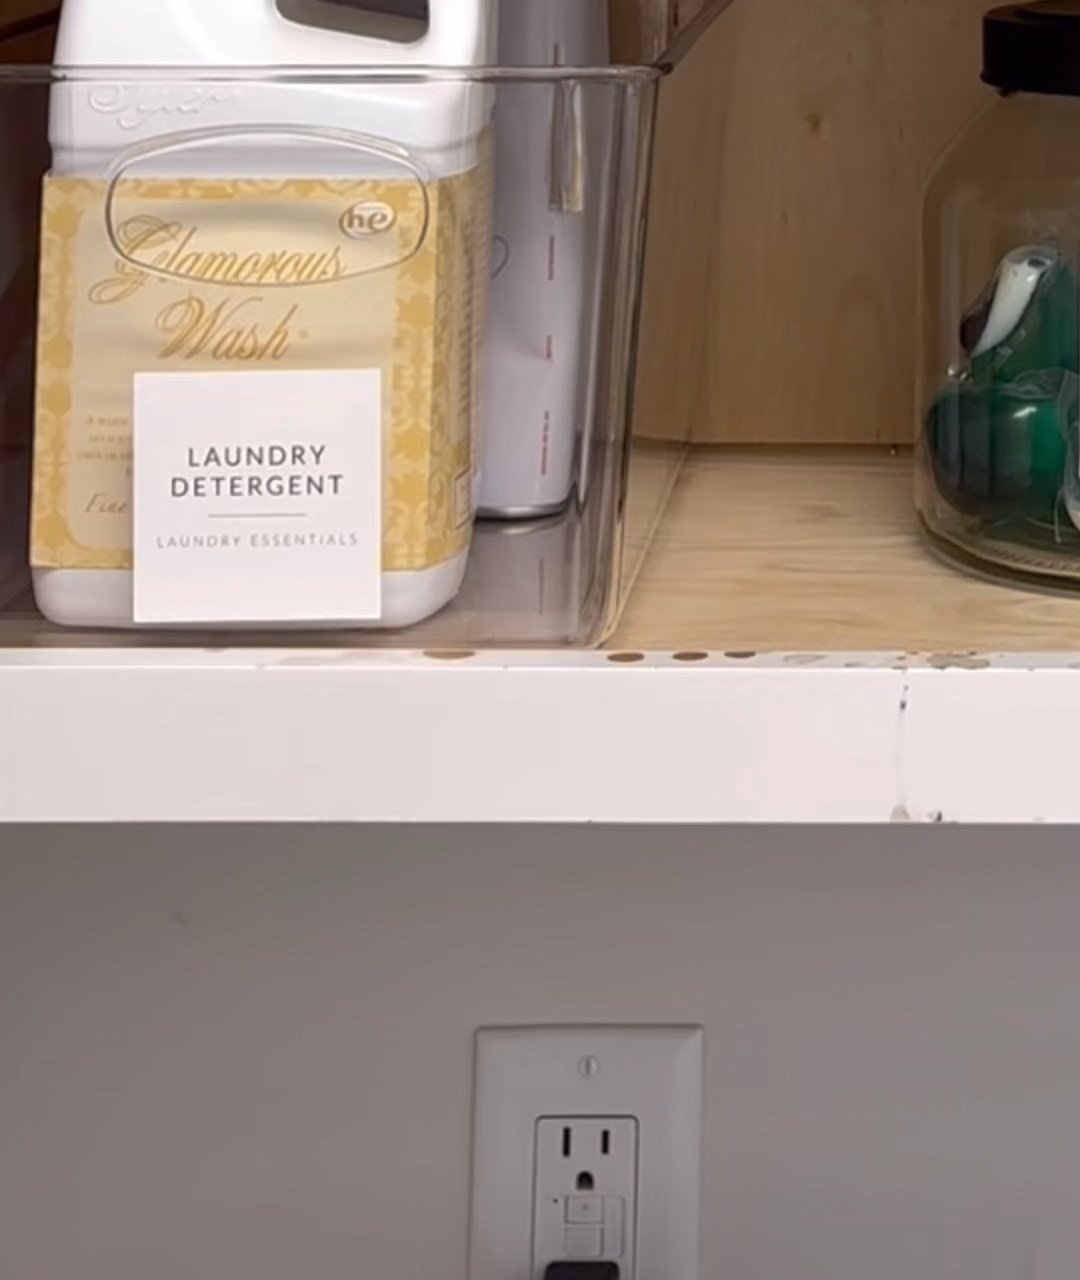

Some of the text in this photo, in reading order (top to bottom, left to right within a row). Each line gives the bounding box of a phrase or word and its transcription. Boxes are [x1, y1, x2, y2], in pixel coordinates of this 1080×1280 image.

[88, 214, 345, 305] Glamorous
[154, 295, 304, 361] Wash
[187, 444, 327, 468] LAUNDRY
[170, 474, 344, 498] DETERGENT
[156, 532, 358, 549] LAUNDRY ESSENTIALS
